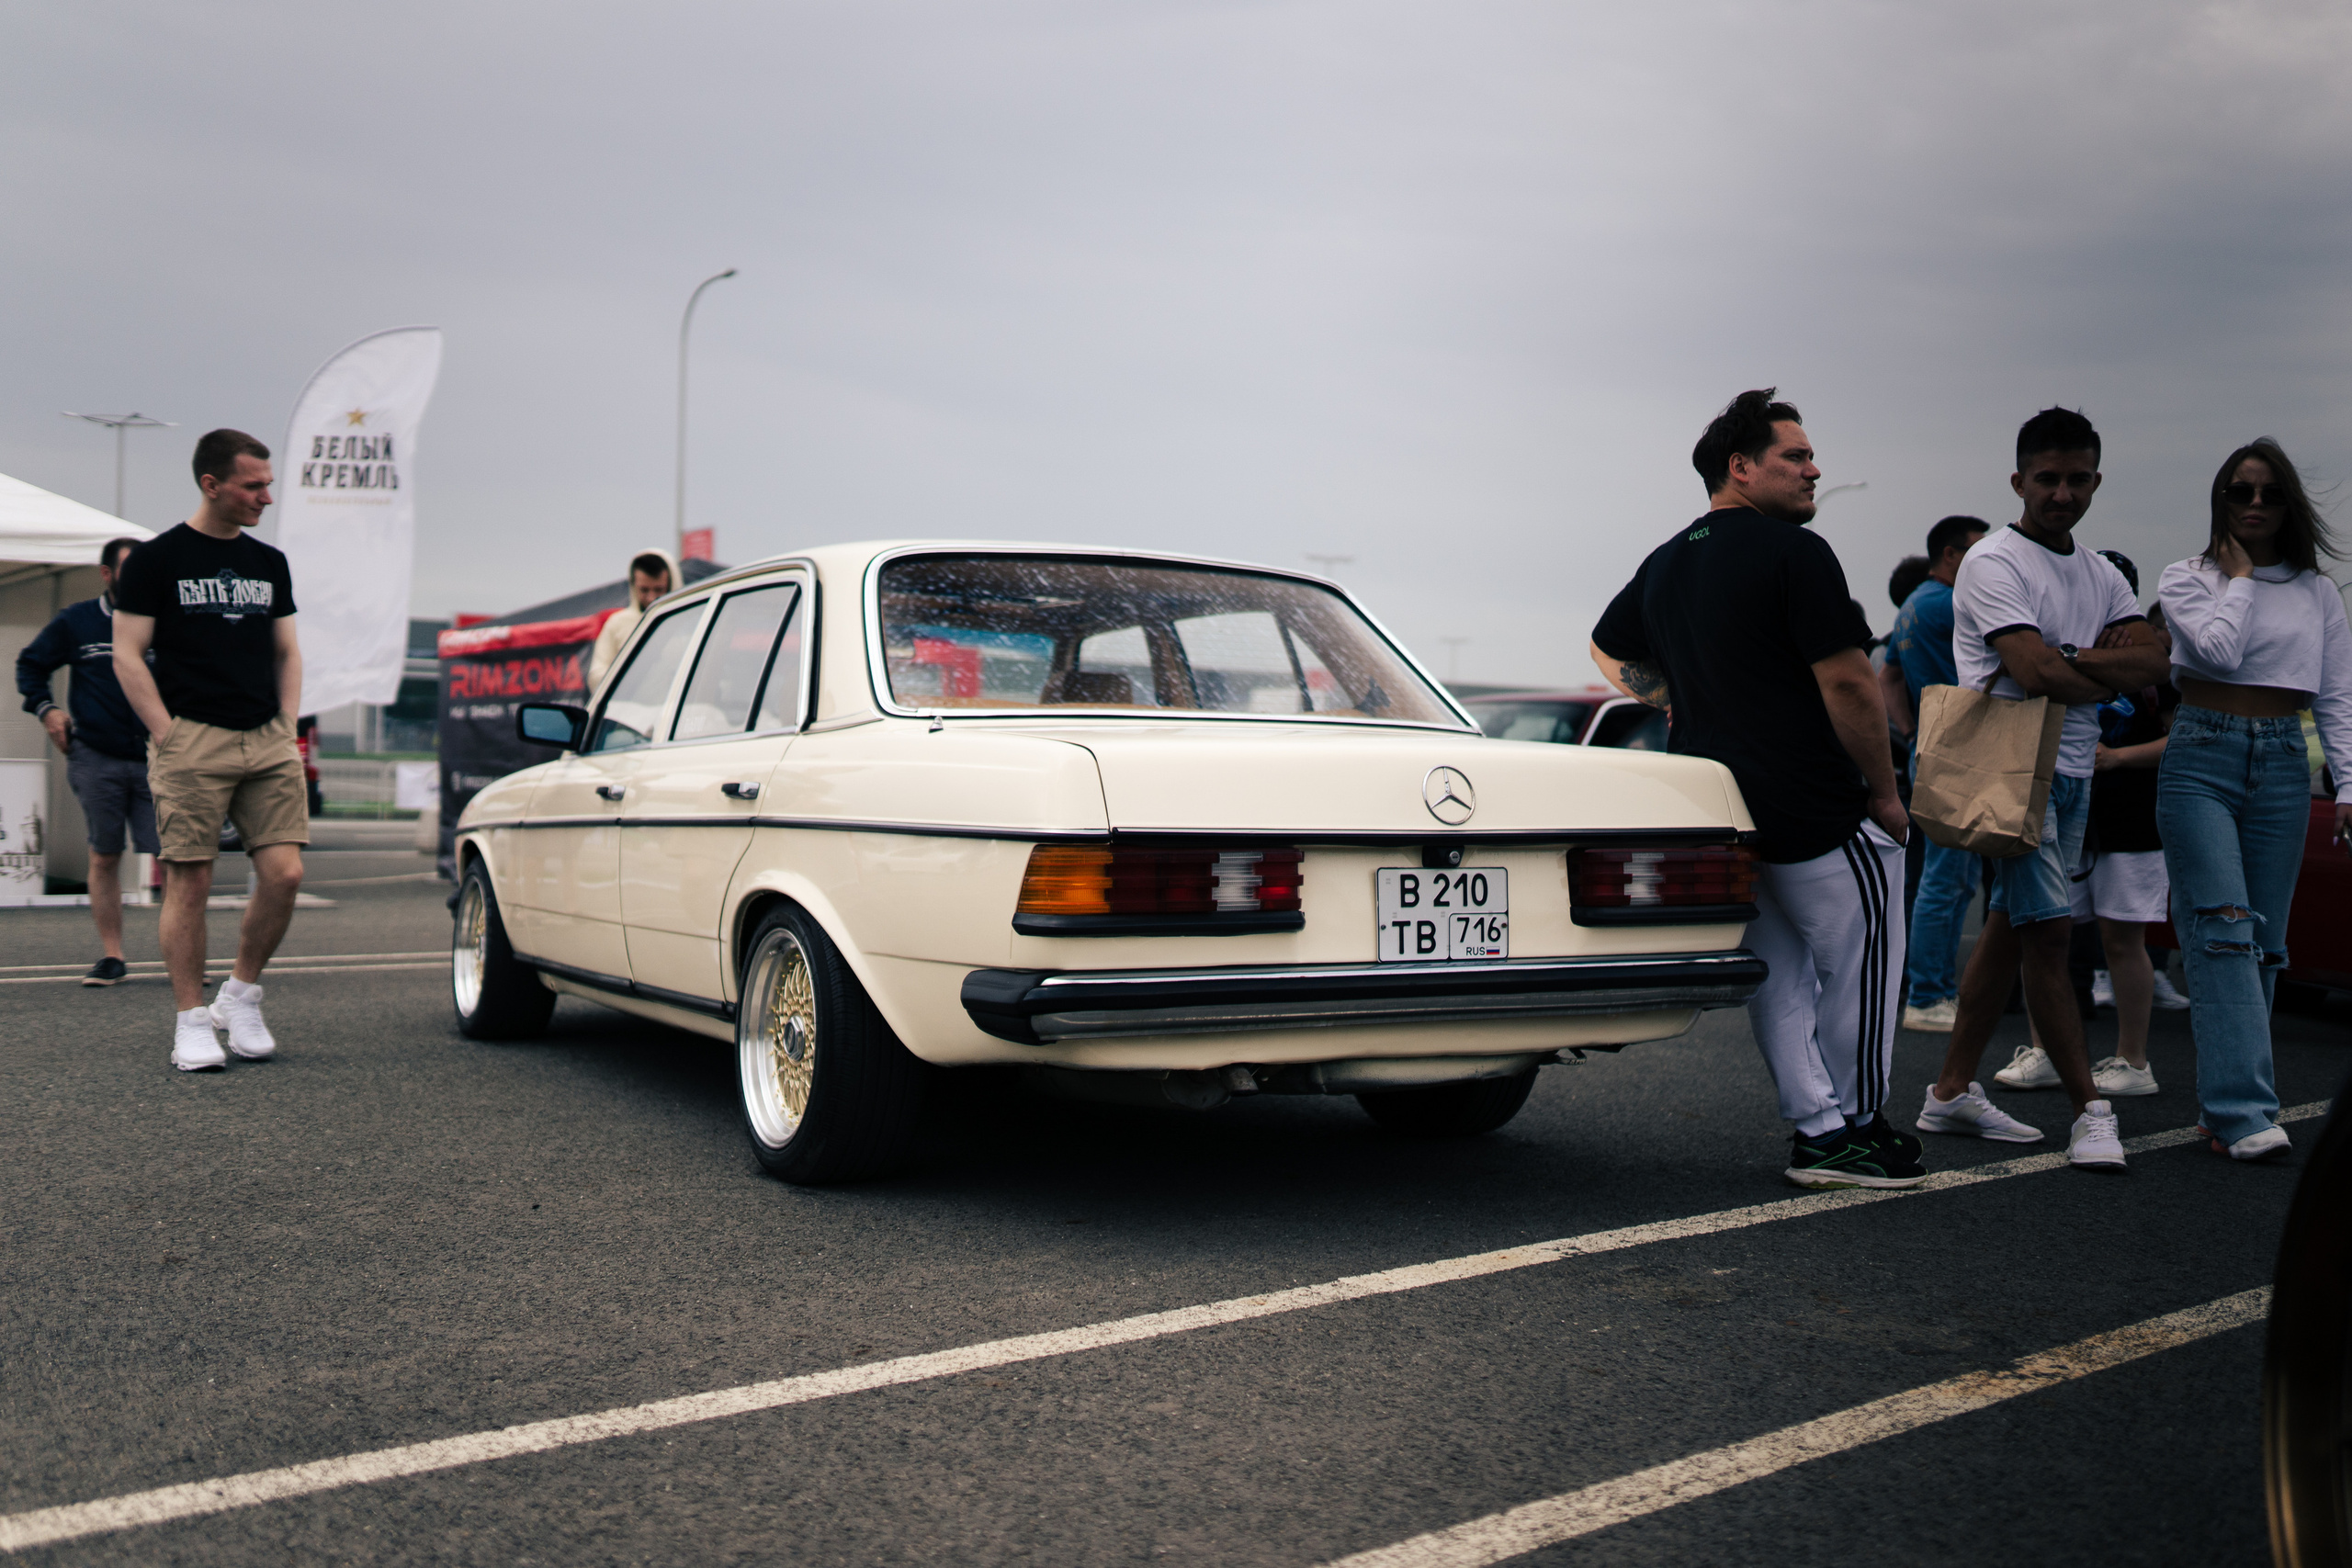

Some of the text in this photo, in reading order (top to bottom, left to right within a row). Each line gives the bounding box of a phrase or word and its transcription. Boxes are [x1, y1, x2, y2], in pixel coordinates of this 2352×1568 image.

[311, 433, 394, 460] БЕЛЫЙ
[301, 462, 399, 490] КРЕМЛЬ
[449, 655, 584, 699] RIMZONA
[1433, 873, 1488, 907] 210
[1456, 917, 1501, 942] 716
[1465, 946, 1486, 956] RUS
